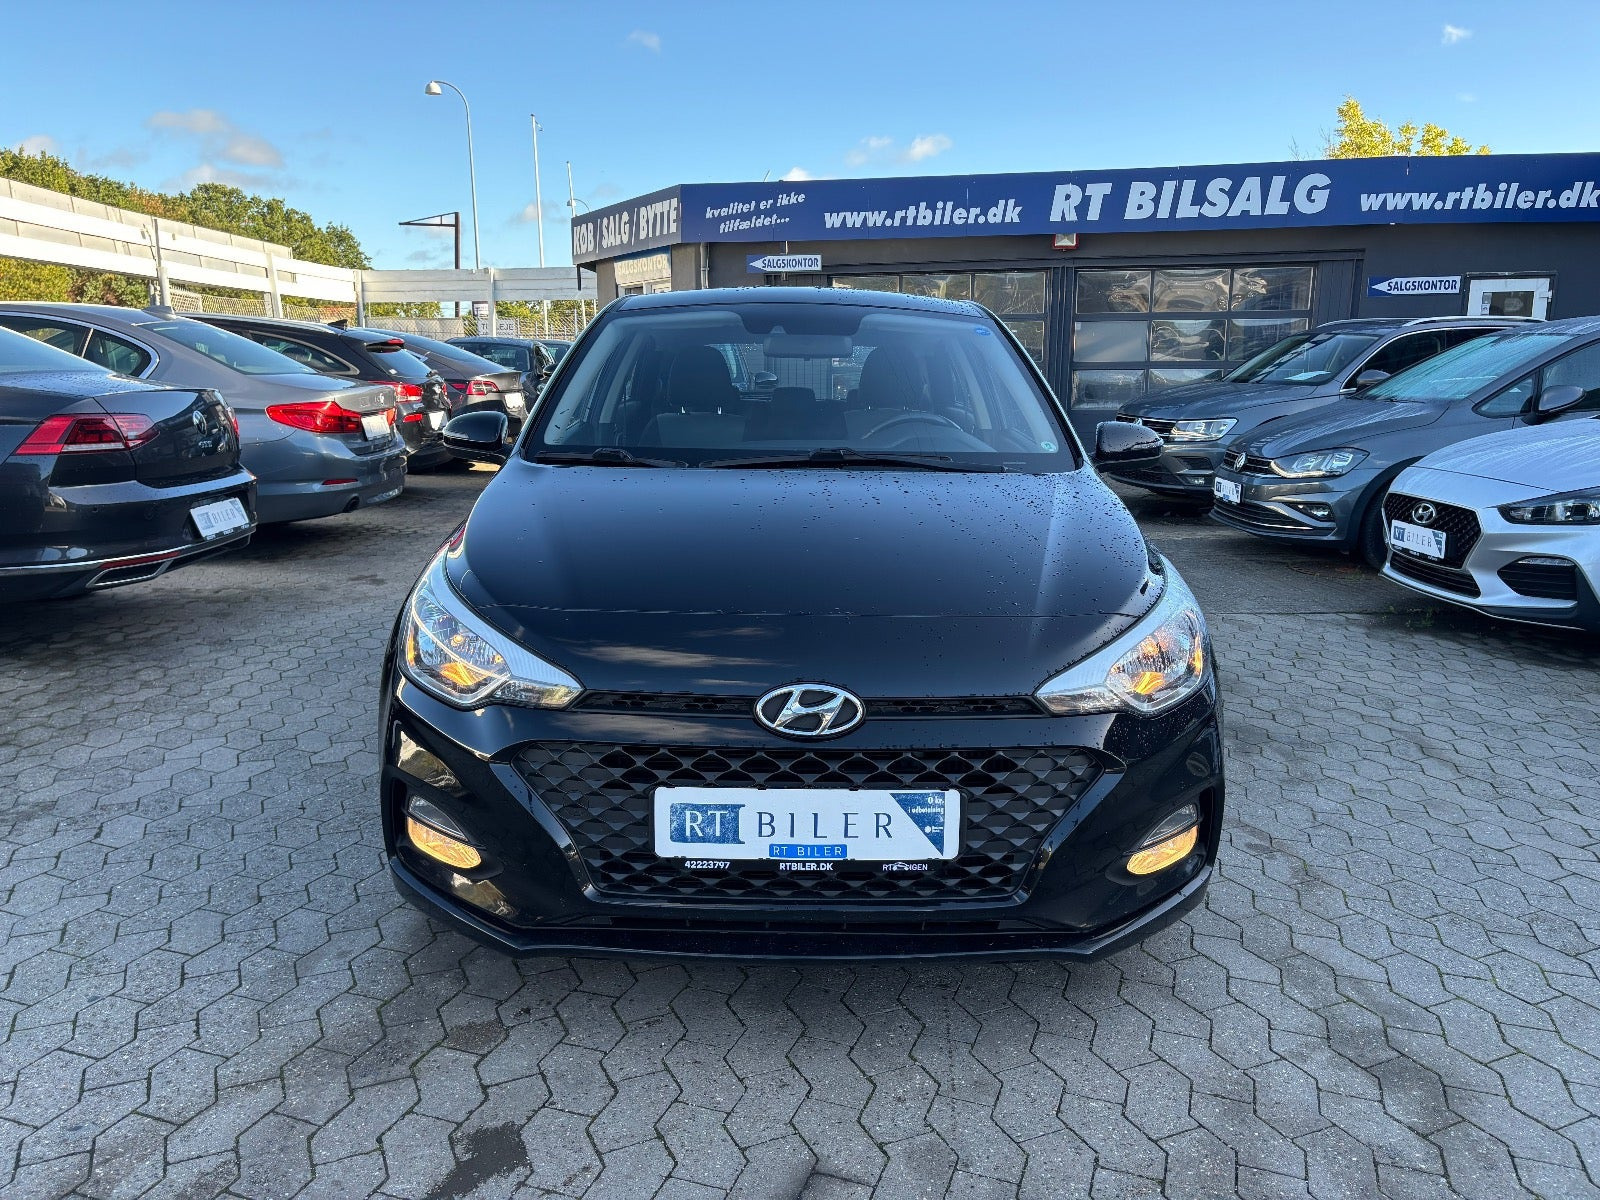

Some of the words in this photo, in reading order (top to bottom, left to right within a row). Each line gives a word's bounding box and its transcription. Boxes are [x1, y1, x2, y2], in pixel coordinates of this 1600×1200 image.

[705, 200, 756, 219] kvalitet
[759, 199, 774, 210] er
[777, 191, 806, 207] ikke
[1050, 182, 1112, 222] RT
[1124, 173, 1332, 220] BILSALG
[1360, 181, 1600, 212] www.rtbiler.dk
[824, 199, 1023, 229] www.rtbiler.dk
[573, 222, 594, 256] KØB
[602, 211, 630, 249] SALG
[639, 198, 678, 240] BYTTE
[617, 253, 668, 275] SALGSKONTOR
[761, 257, 819, 269] SALGSKONTOR
[1386, 279, 1458, 292] SALGSKONTOR
[1406, 531, 1432, 548] BILER
[684, 809, 729, 838] RT
[756, 811, 893, 839] BILER
[772, 845, 787, 856] RT
[797, 845, 843, 857] BILER
[684, 860, 731, 870] 42223797
[779, 861, 834, 871] RTBILER.DK
